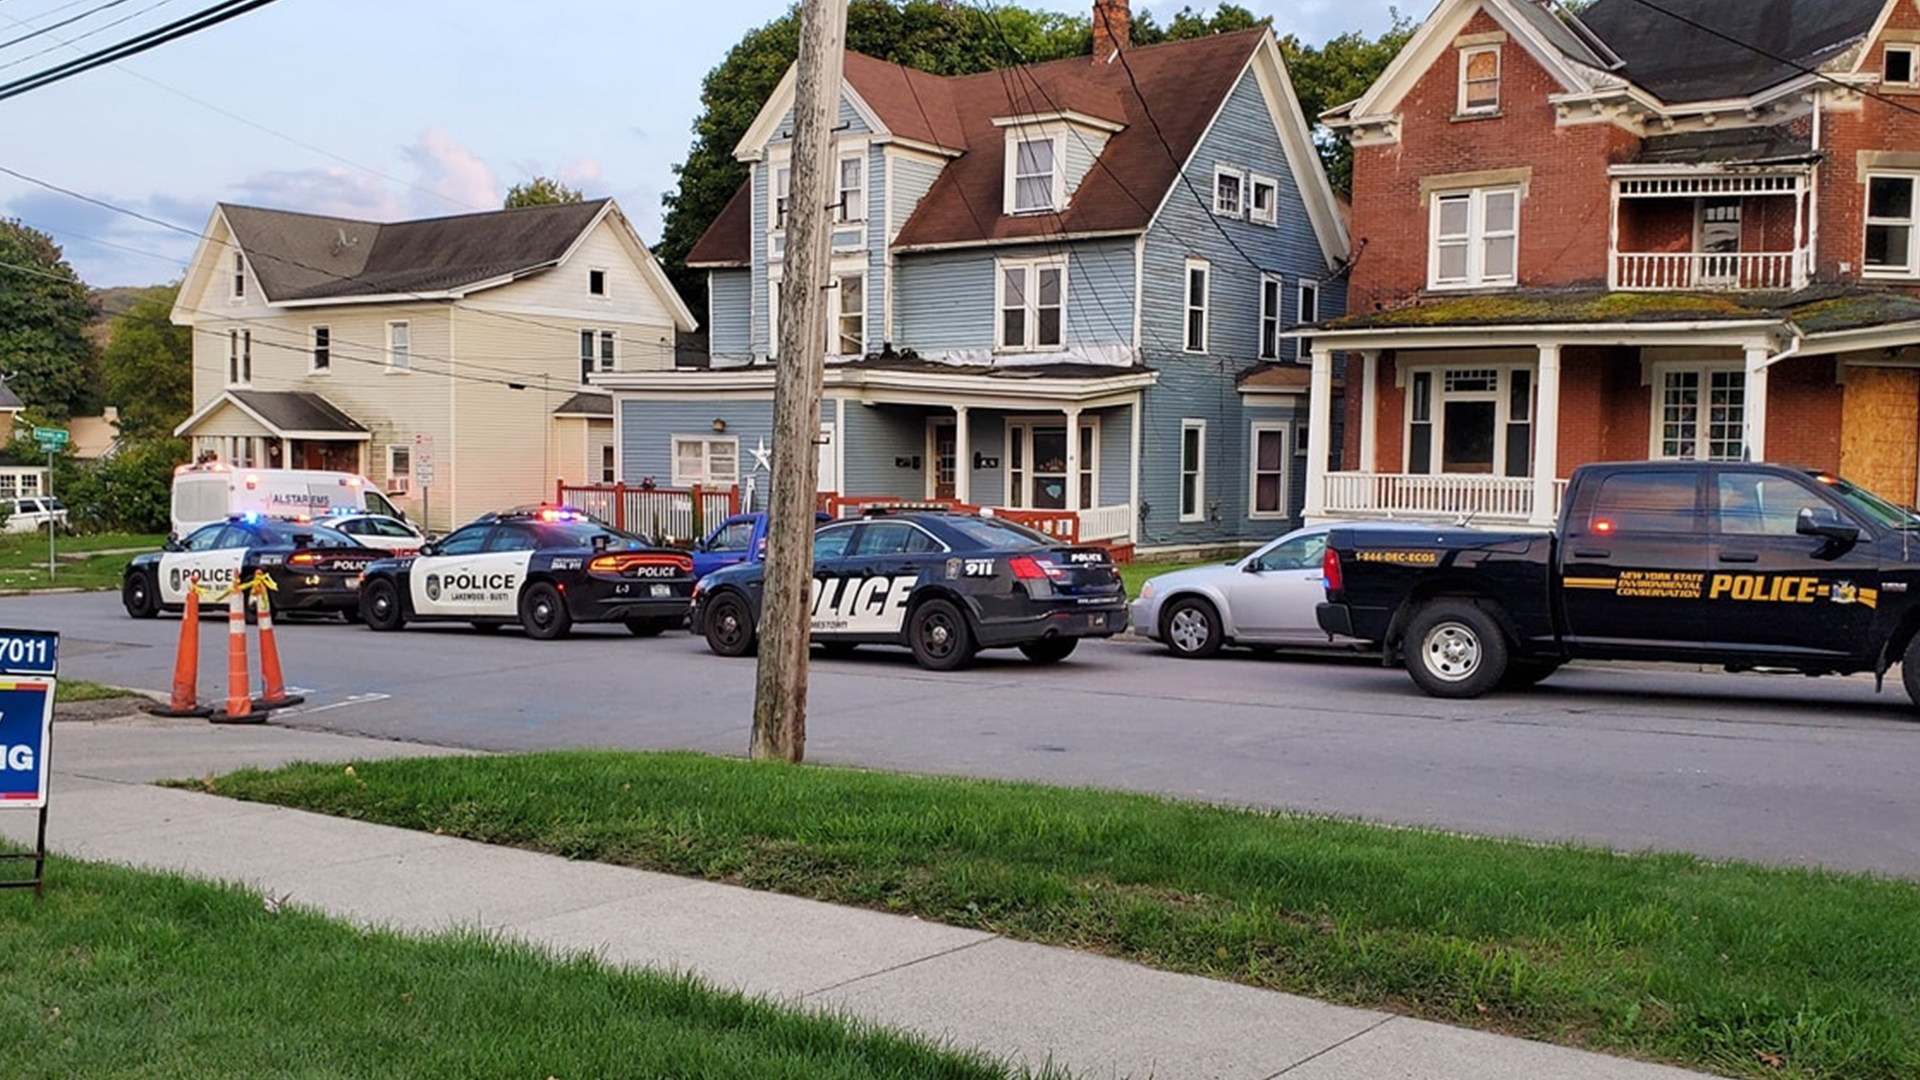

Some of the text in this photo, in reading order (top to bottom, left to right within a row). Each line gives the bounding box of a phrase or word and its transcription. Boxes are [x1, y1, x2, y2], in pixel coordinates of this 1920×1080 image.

[272, 494, 308, 504] ALSTAR
[1072, 554, 1102, 562] POLICE
[333, 560, 368, 570] POLIC
[965, 563, 993, 576] 911
[182, 568, 232, 582] POLICE
[637, 567, 676, 577] POLICE
[1620, 571, 1705, 582] NEW YORK STATE
[444, 574, 515, 590] POLICE
[1618, 580, 1701, 589] ENVIRONMENTAL
[1616, 588, 1701, 598] CONSERVATION
[1709, 574, 1819, 603] POLICE
[811, 576, 919, 619] LICE
[0, 638, 46, 663] 7011
